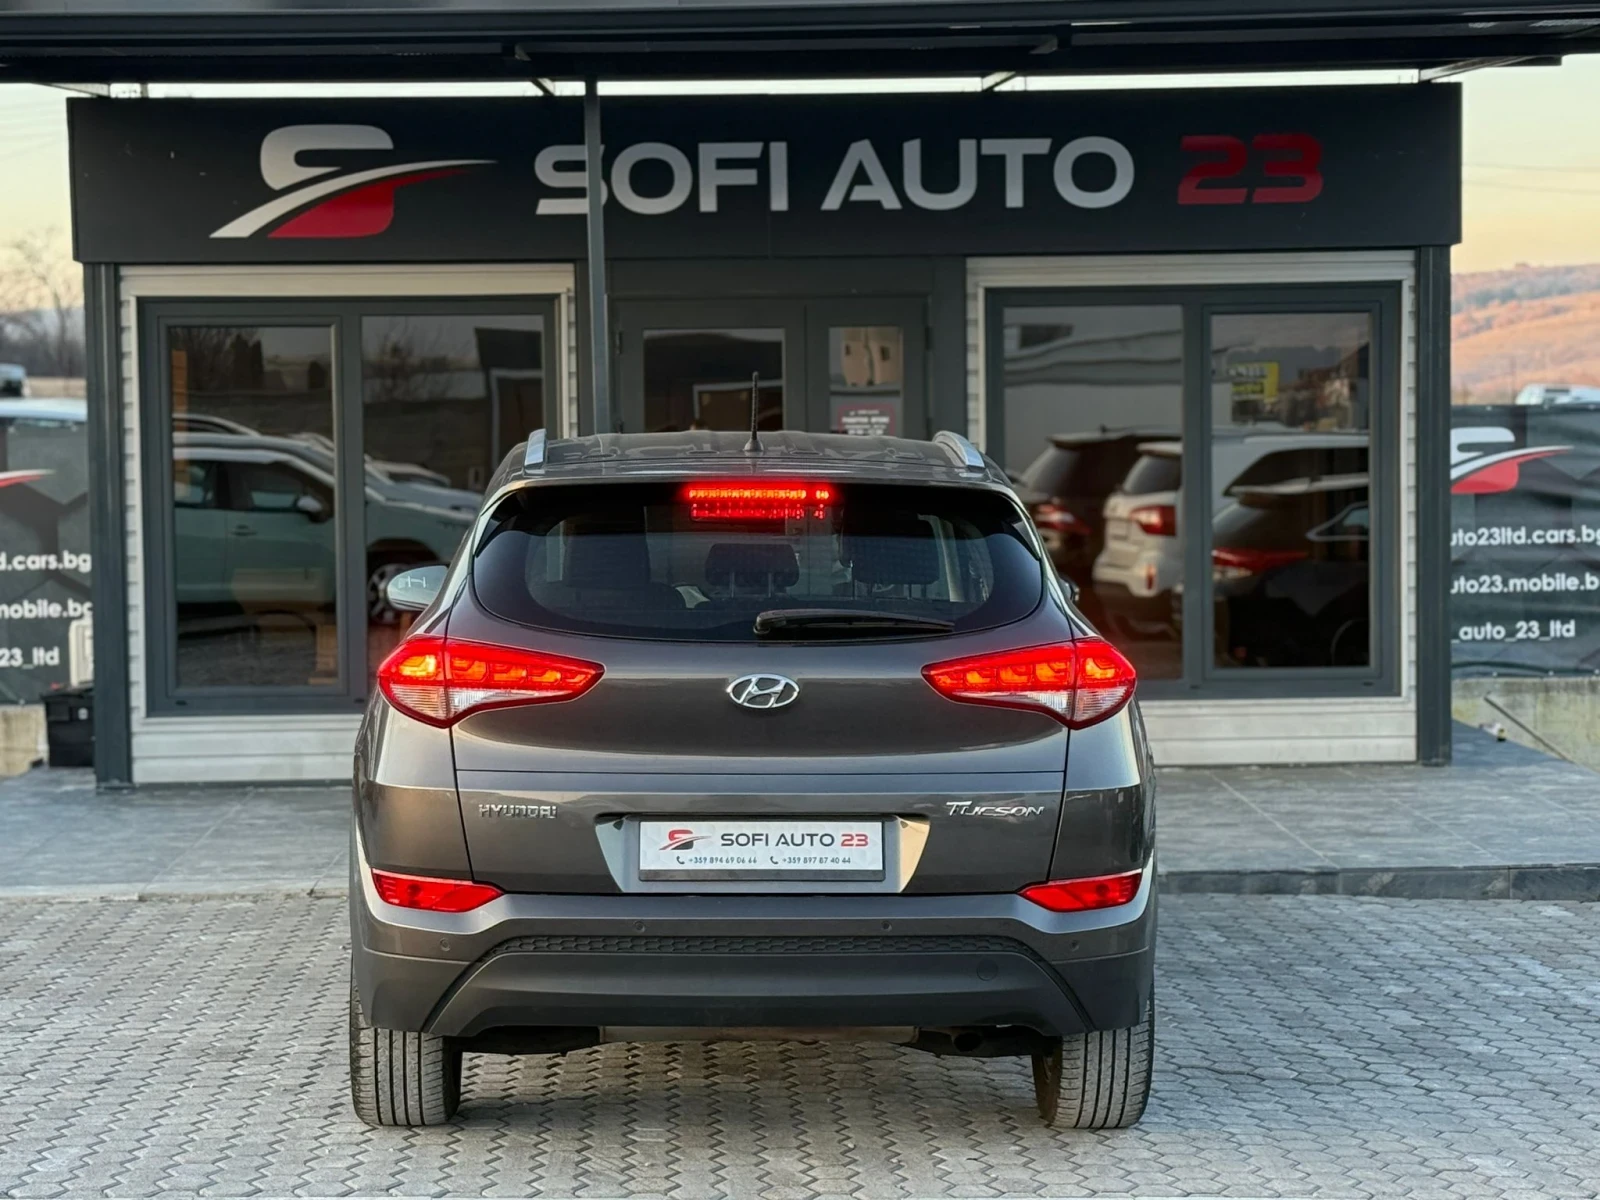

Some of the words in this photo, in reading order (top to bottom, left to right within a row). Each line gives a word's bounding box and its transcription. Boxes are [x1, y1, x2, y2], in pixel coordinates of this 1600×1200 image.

[534, 141, 789, 215] SOFI
[820, 136, 1135, 211] AUTO
[1177, 132, 1324, 205] 23
[478, 804, 557, 818] HYUNDAI
[946, 801, 1045, 817] TUCSON
[720, 833, 769, 847] SOFI
[775, 833, 835, 847] AUTO
[840, 833, 869, 847] 23
[689, 856, 707, 865] +359
[709, 856, 723, 865] 894
[725, 856, 735, 865] 69
[736, 856, 746, 865] 06
[748, 856, 757, 865] 66
[782, 856, 801, 865] +359
[803, 856, 817, 865] 897
[819, 856, 829, 865] 87
[830, 856, 840, 865] 40
[841, 856, 851, 865] 44
